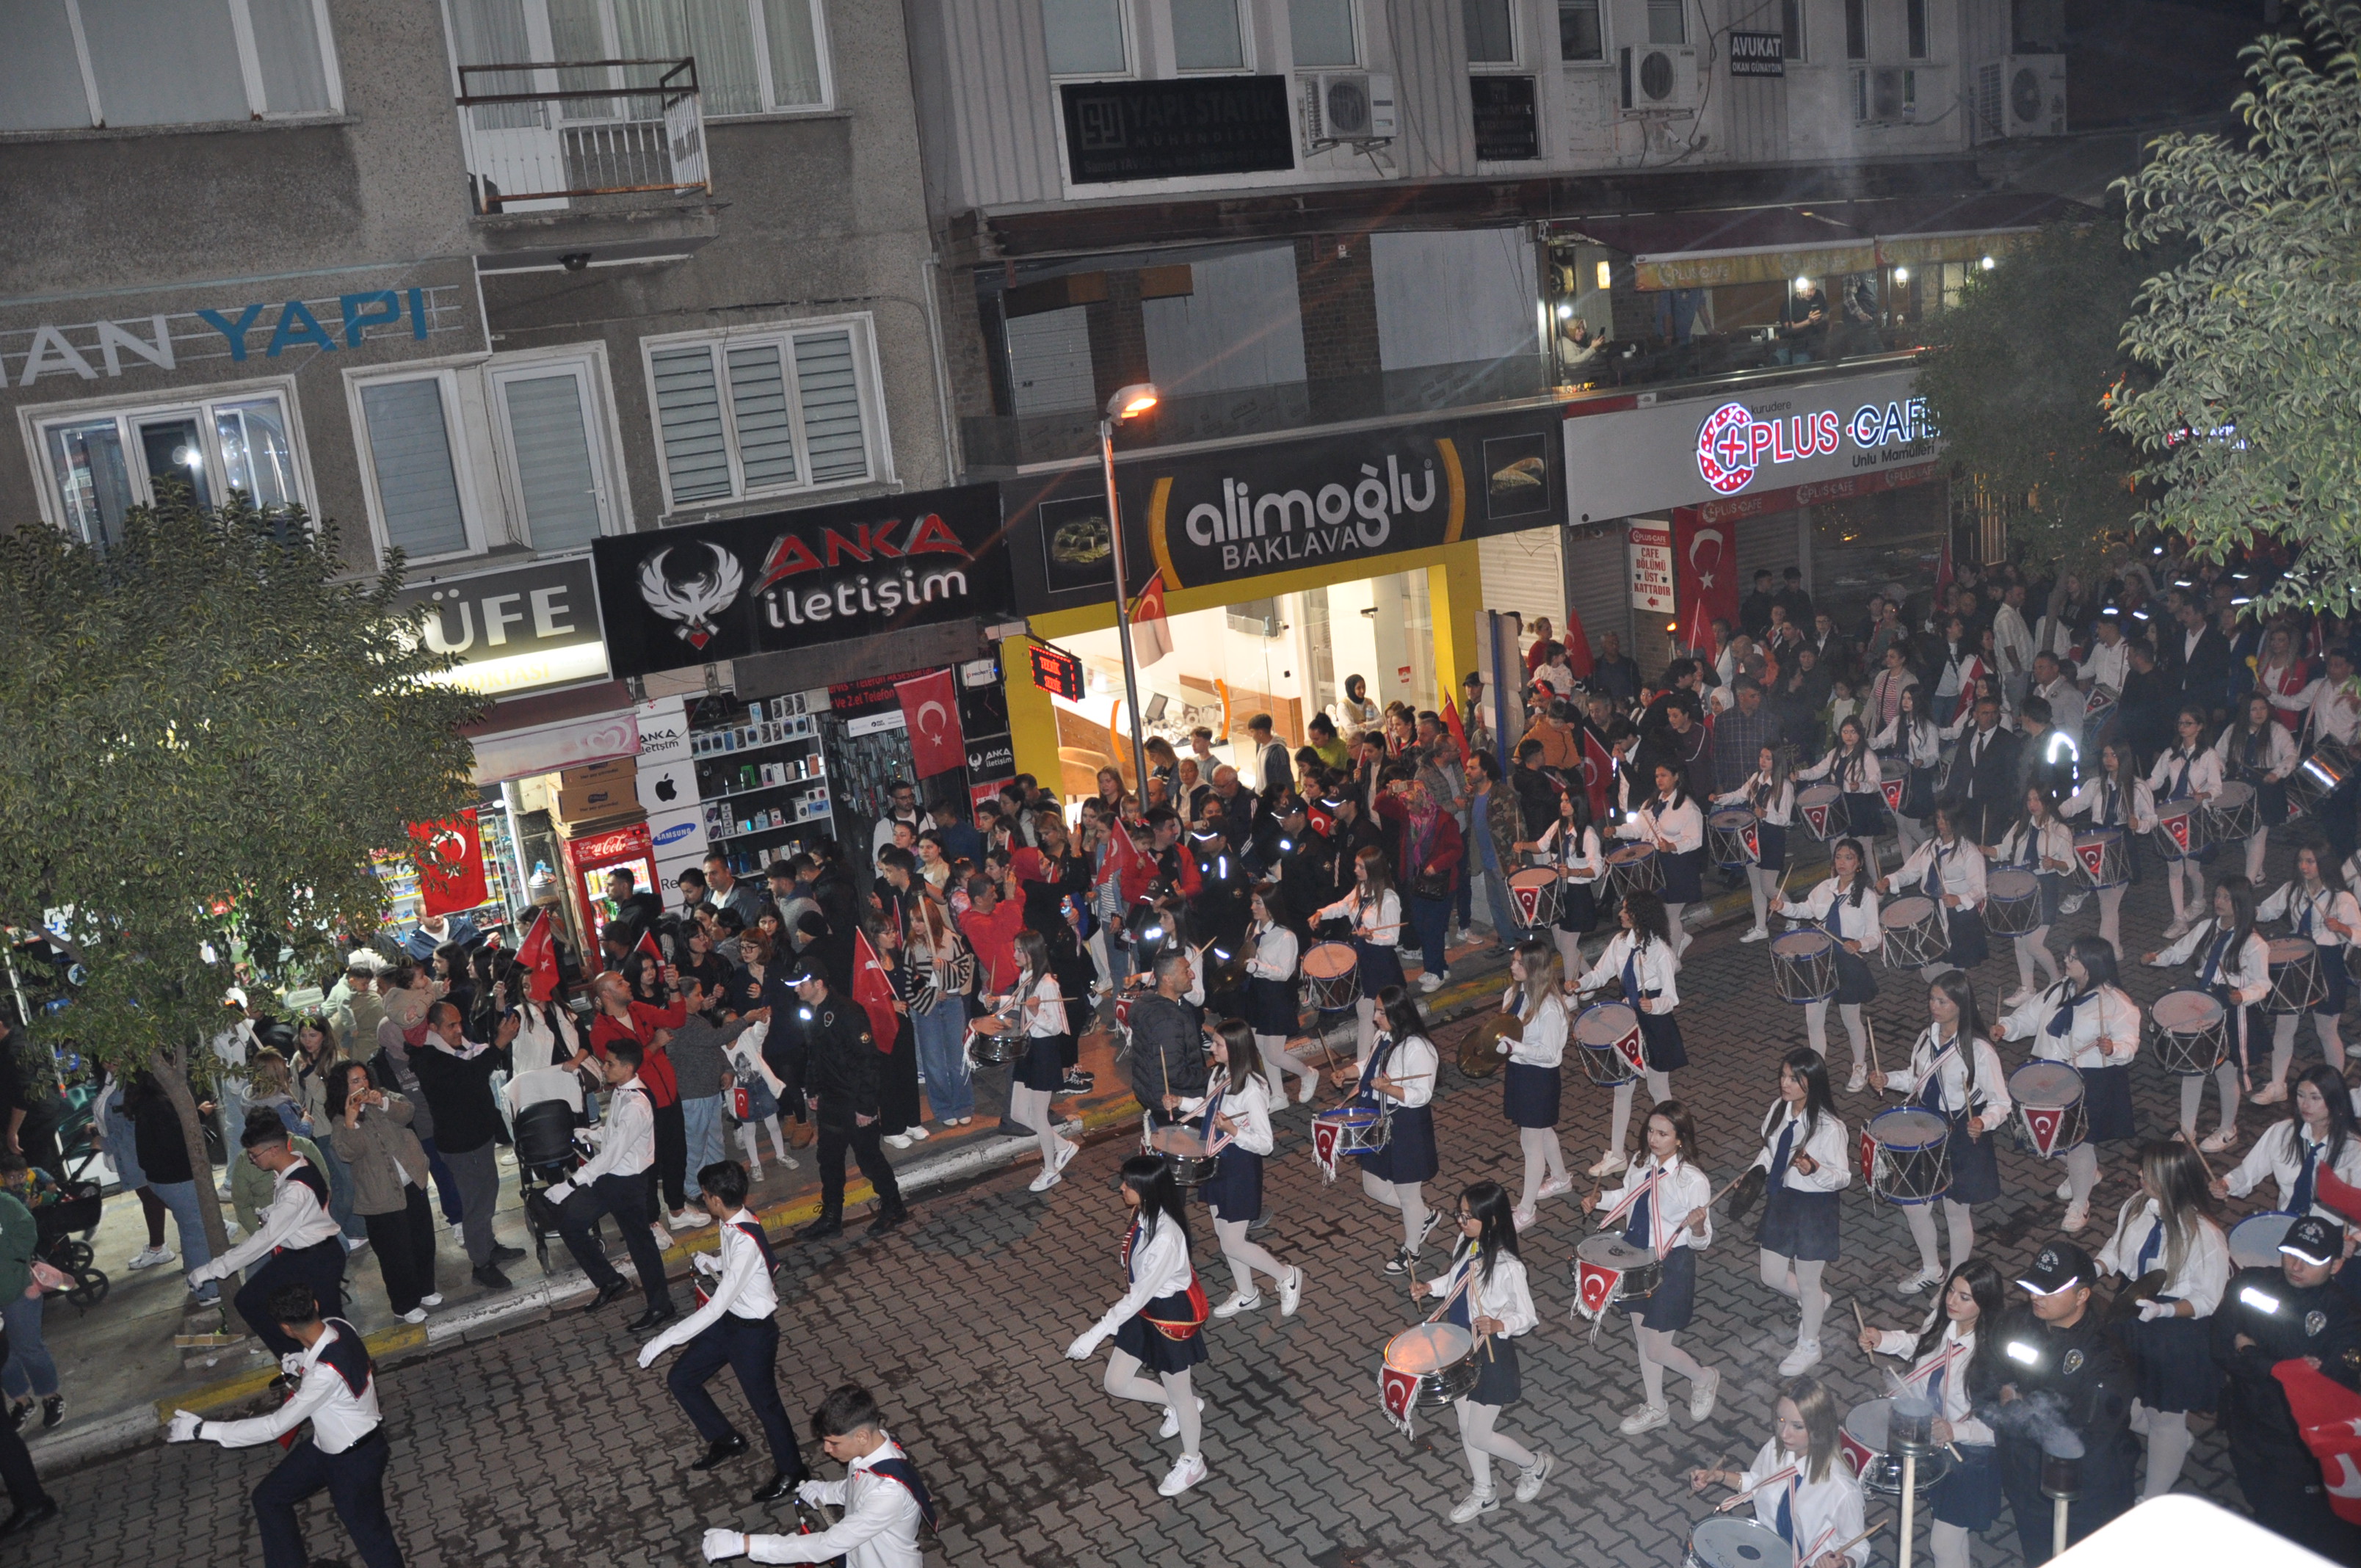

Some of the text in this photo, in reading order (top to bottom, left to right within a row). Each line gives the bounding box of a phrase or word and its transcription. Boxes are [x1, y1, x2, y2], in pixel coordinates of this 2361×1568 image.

[1732, 36, 1781, 57] AVUKAT
[1732, 61, 1750, 72] OKAN
[0, 288, 428, 388] AN YAPI
[1751, 401, 1792, 416] kurudere
[1749, 410, 1840, 467] PLUS
[1852, 453, 1876, 468] Unlu
[1714, 503, 1737, 516] PLUS
[750, 513, 975, 596] ANKA
[1222, 526, 1361, 570] BAKLAVA
[1642, 548, 1659, 559] CAFE
[1636, 556, 1667, 572] BÖLÜMÜ
[1644, 570, 1658, 583] ÜST
[1634, 582, 1671, 596] KATTADIR
[766, 569, 968, 629] iletişim
[863, 688, 895, 703] Telefon
[639, 729, 677, 744] ANKA
[641, 741, 679, 753] letişim
[984, 747, 1013, 762] ANKA
[986, 757, 1012, 768] iletişim
[656, 827, 692, 841] SAMSUNG
